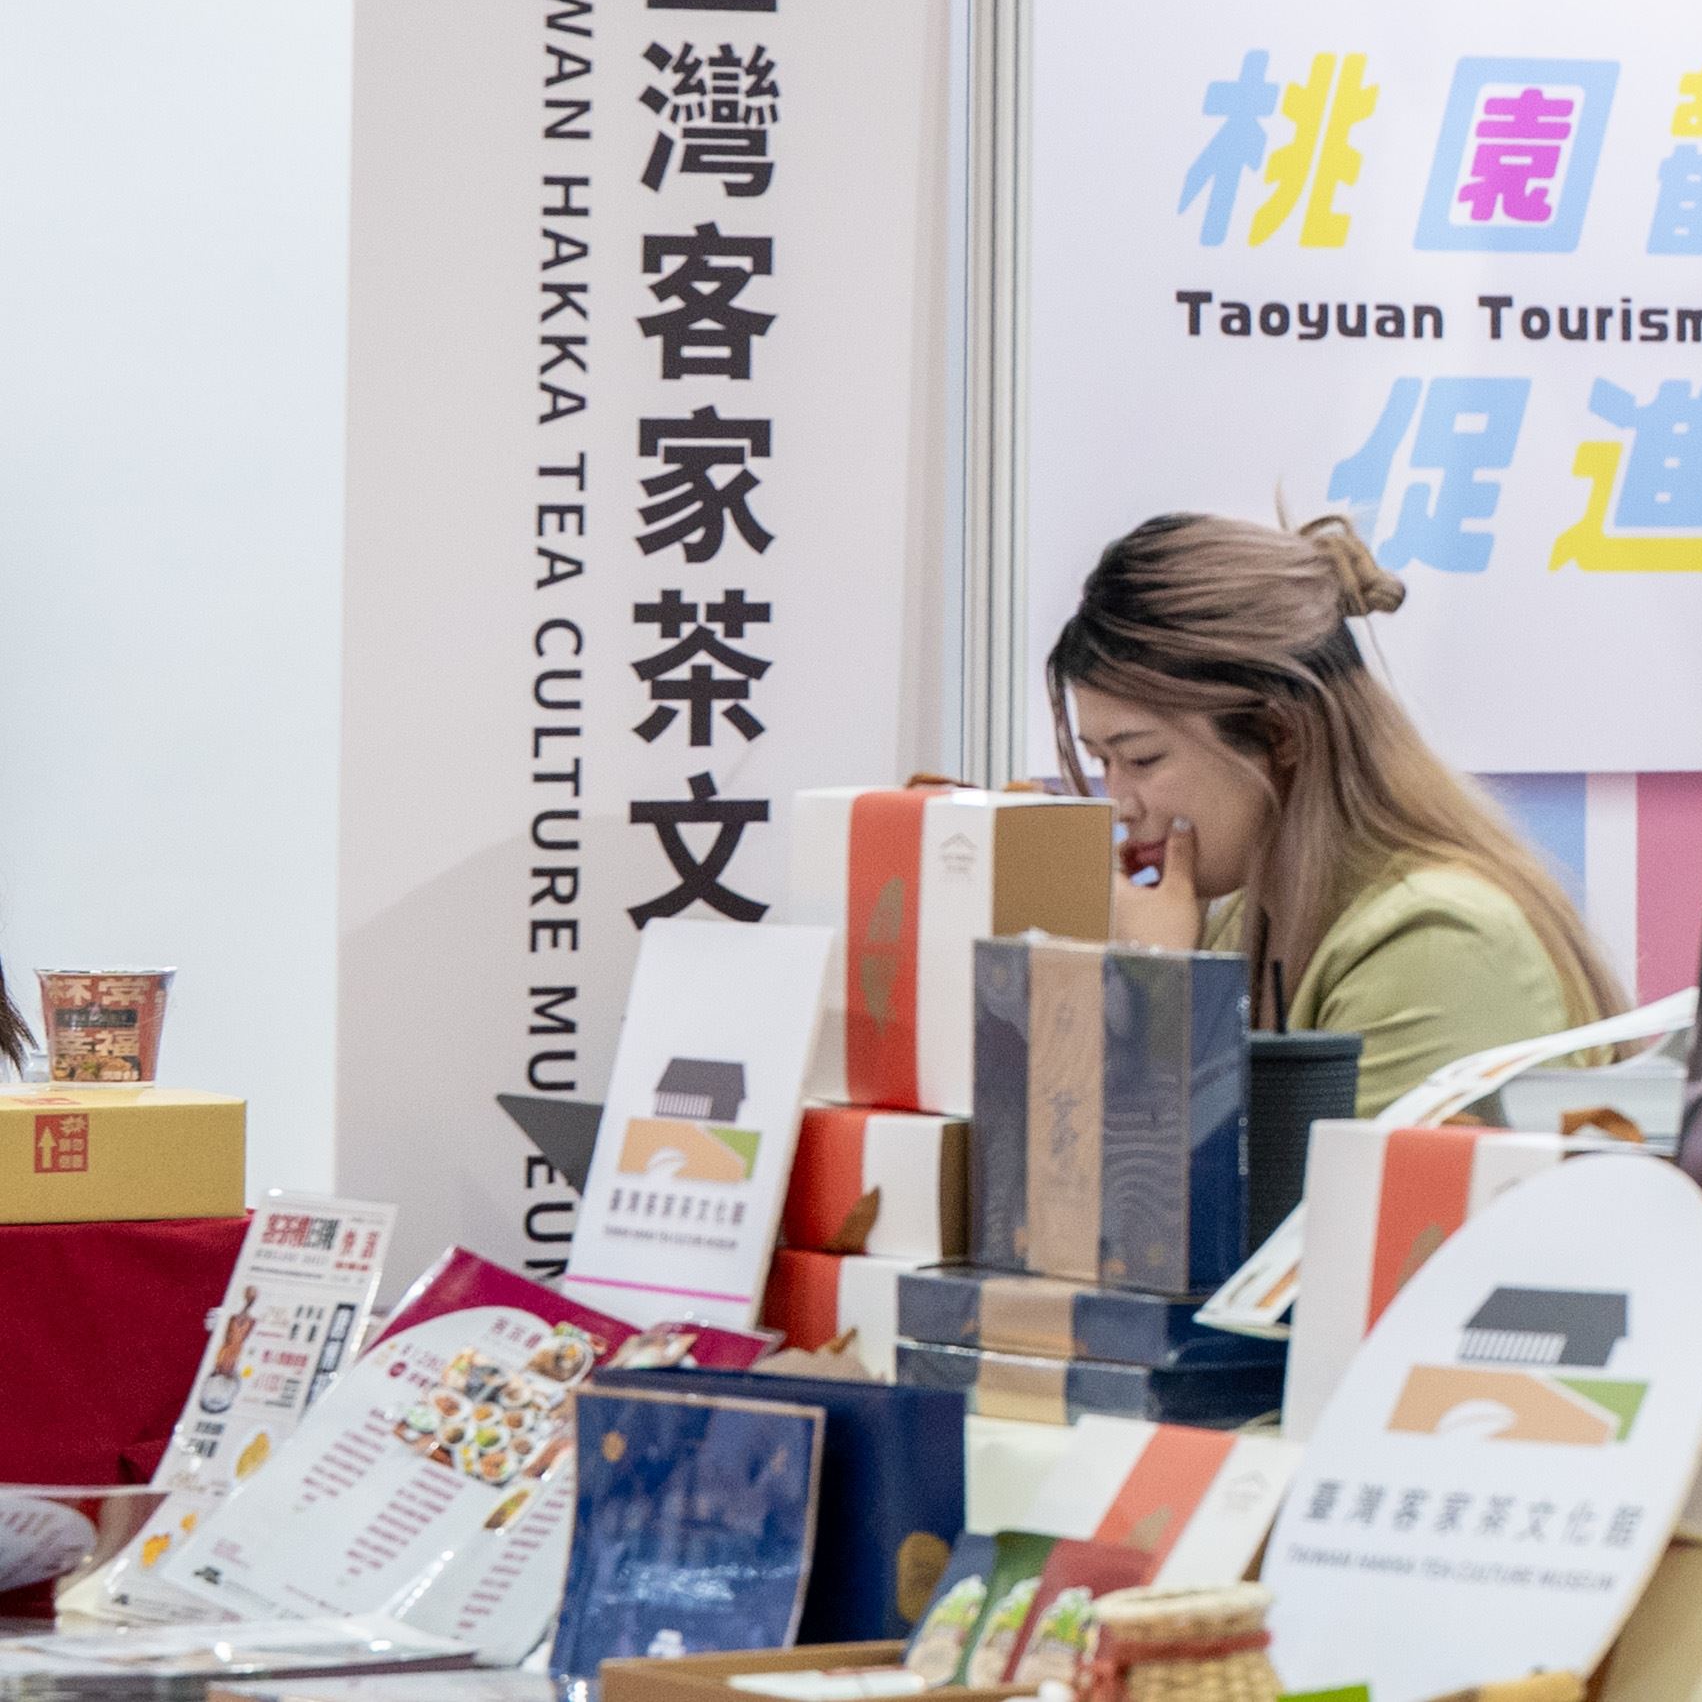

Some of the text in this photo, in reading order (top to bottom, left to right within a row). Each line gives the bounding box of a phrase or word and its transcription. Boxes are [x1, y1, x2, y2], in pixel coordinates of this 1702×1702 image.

[537, 175, 591, 425] HAKKA
[1175, 289, 1445, 342] Taoyuan
[535, 451, 587, 590] TEA
[527, 618, 584, 954] CULTURE
